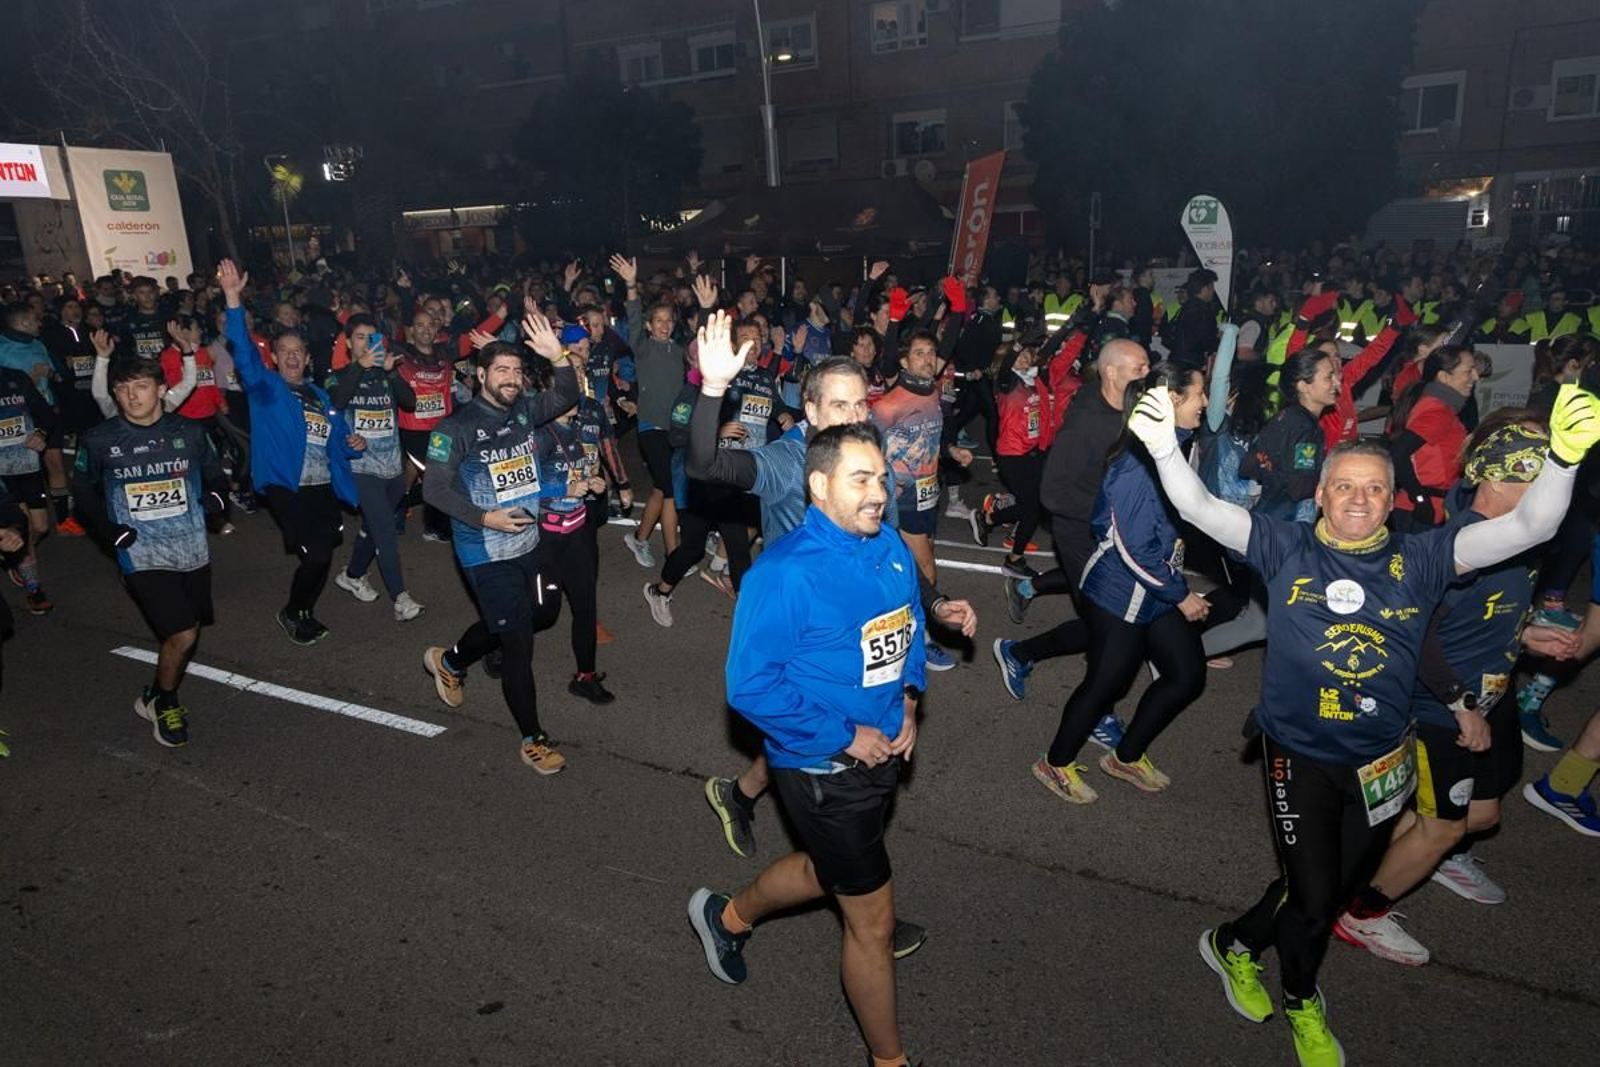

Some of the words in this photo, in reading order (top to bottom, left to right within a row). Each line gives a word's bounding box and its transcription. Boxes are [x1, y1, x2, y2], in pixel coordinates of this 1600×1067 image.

[106, 221, 161, 231] calderón
[416, 399, 442, 410] 9057
[745, 402, 770, 418] 4617
[359, 418, 391, 429] 7972
[480, 447, 508, 463] SAN
[113, 465, 142, 479] SAN
[147, 457, 189, 476] ANTÓN
[497, 465, 534, 487] 9368
[132, 489, 182, 507] 7324
[869, 623, 913, 661] 5578
[1324, 623, 1386, 645] SENDERISMO
[1319, 710, 1354, 721] ANTON
[1270, 757, 1300, 846] calderón
